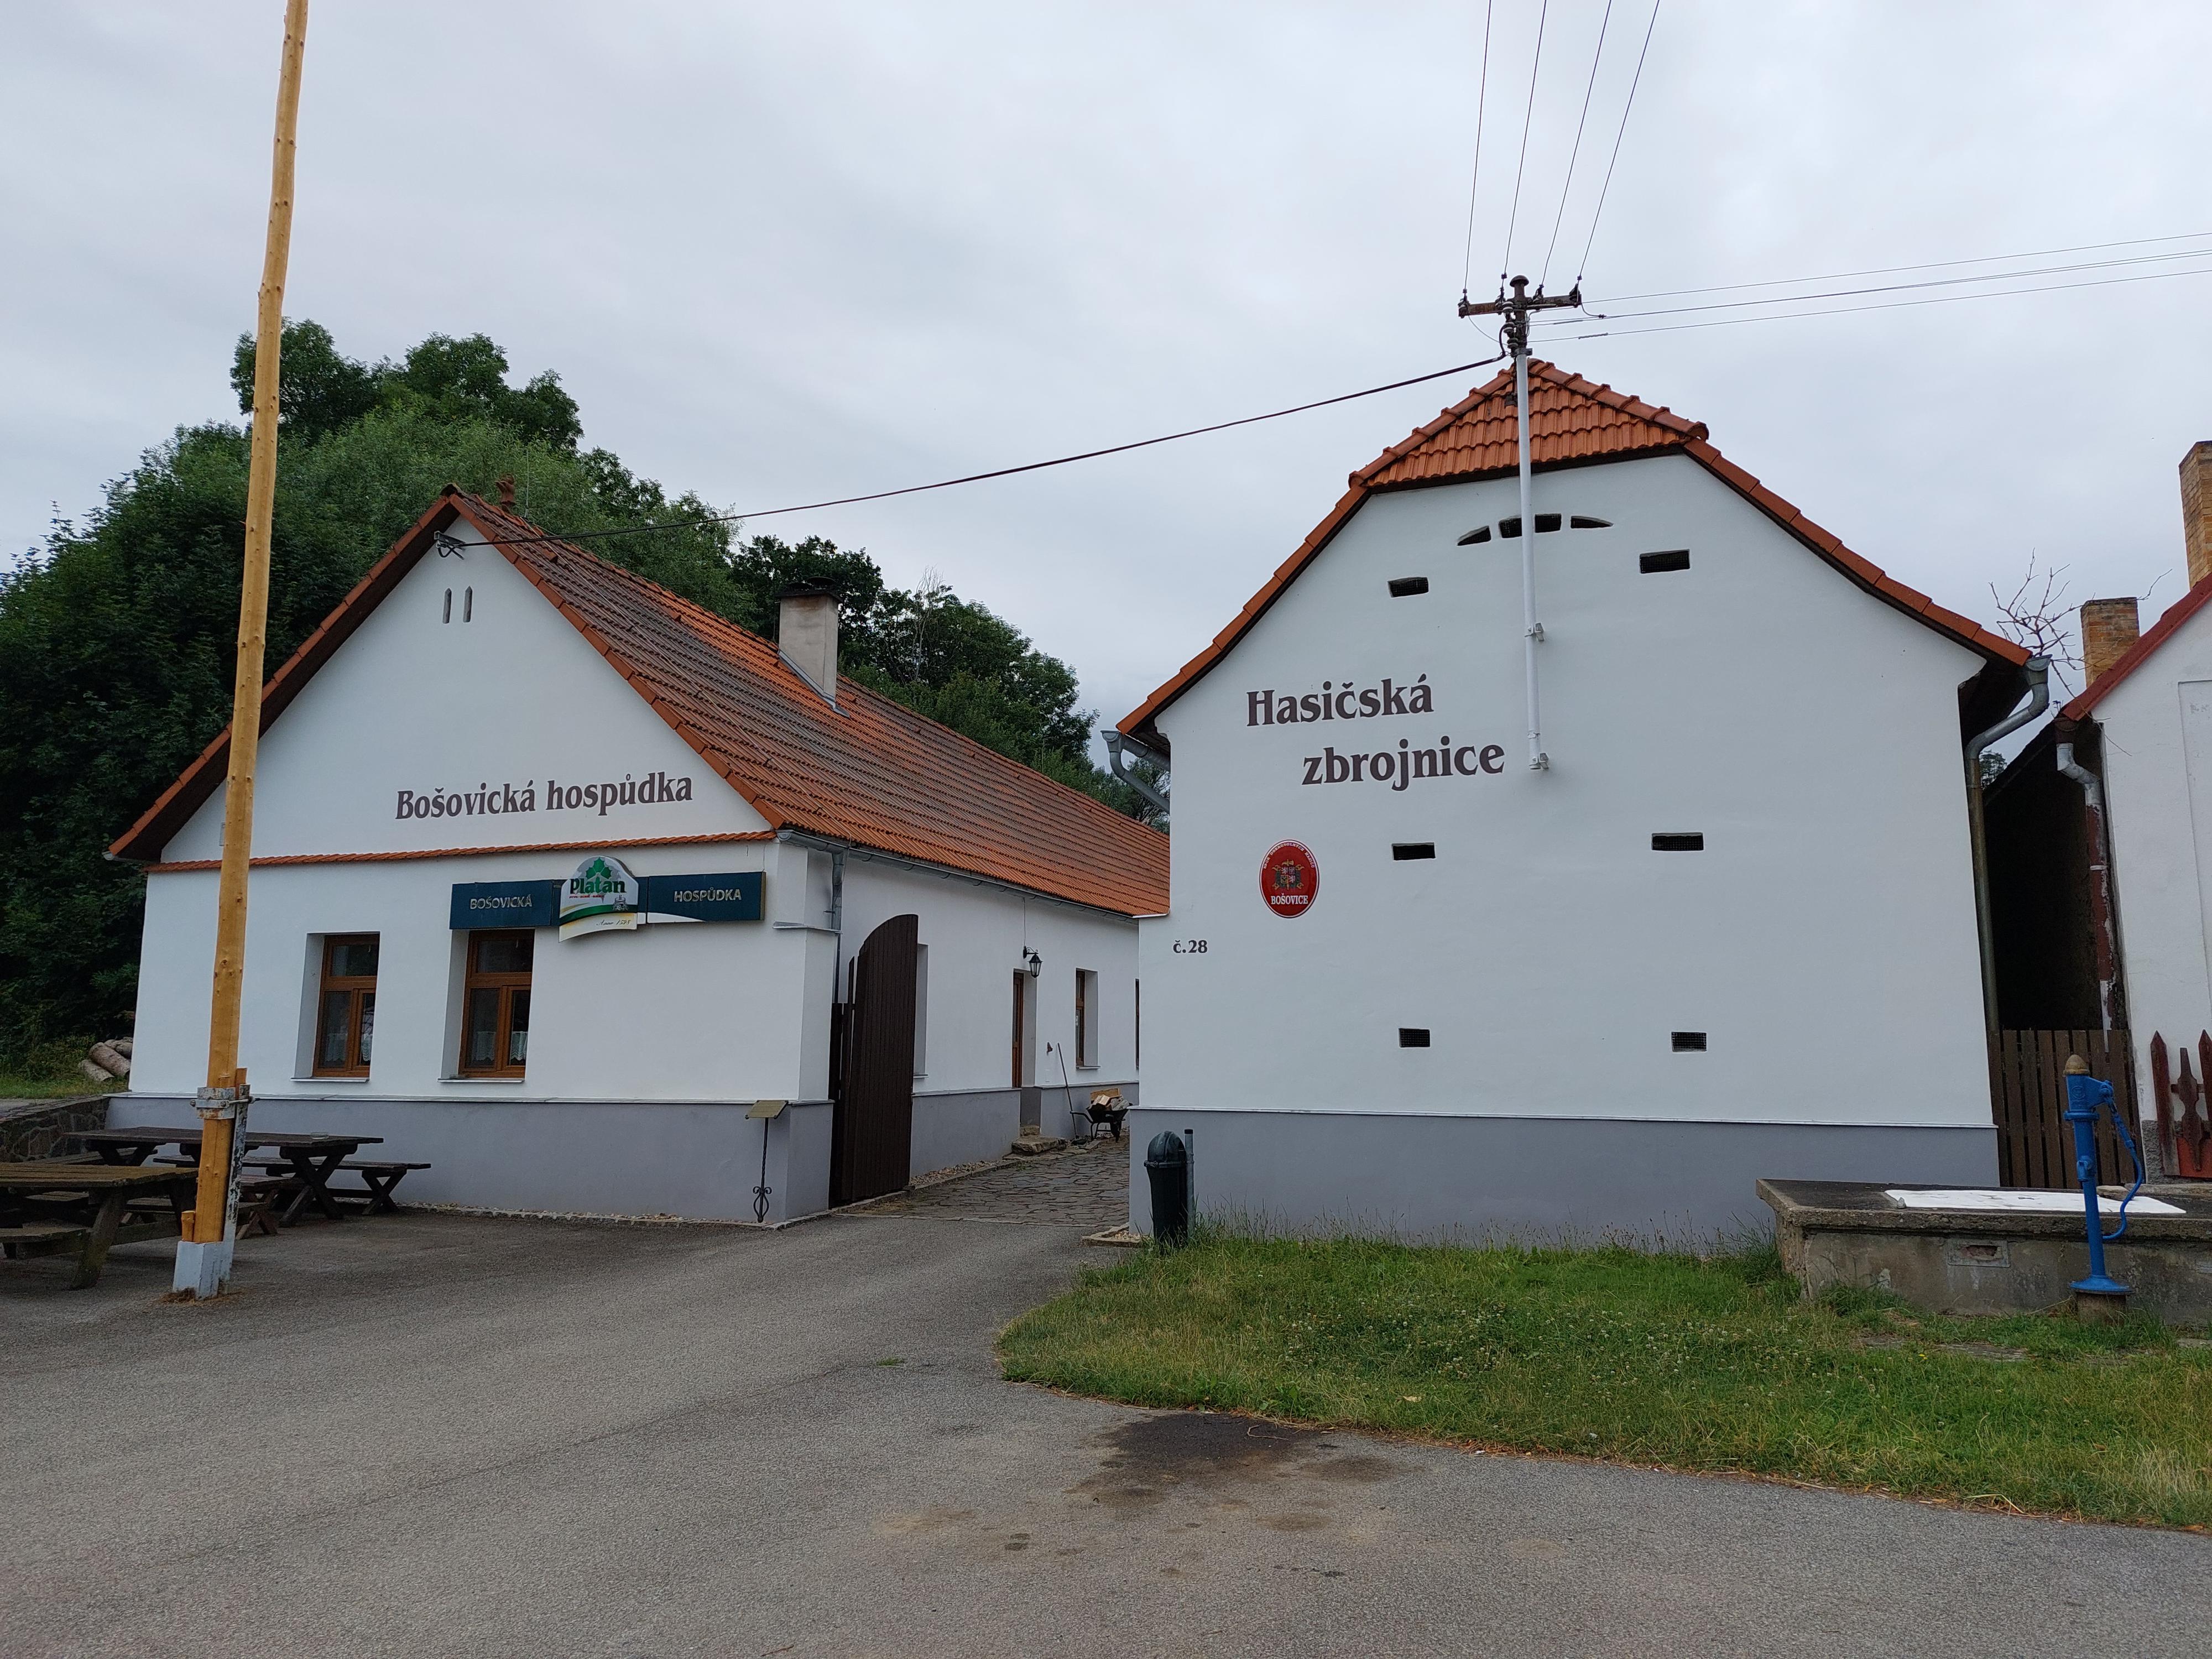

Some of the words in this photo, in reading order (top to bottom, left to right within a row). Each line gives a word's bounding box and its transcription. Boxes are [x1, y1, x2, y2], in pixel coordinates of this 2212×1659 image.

[1246, 673, 1434, 727] Hasičská
[1301, 735, 1505, 791] zbrojnice
[395, 779, 536, 820] Bošovická
[545, 771, 693, 816] hospůdka
[570, 876, 627, 894] Platan
[674, 886, 742, 902] HOSPŮDKA
[1270, 893, 1309, 905] BOŠOVICE
[1173, 939, 1208, 954] č.28
